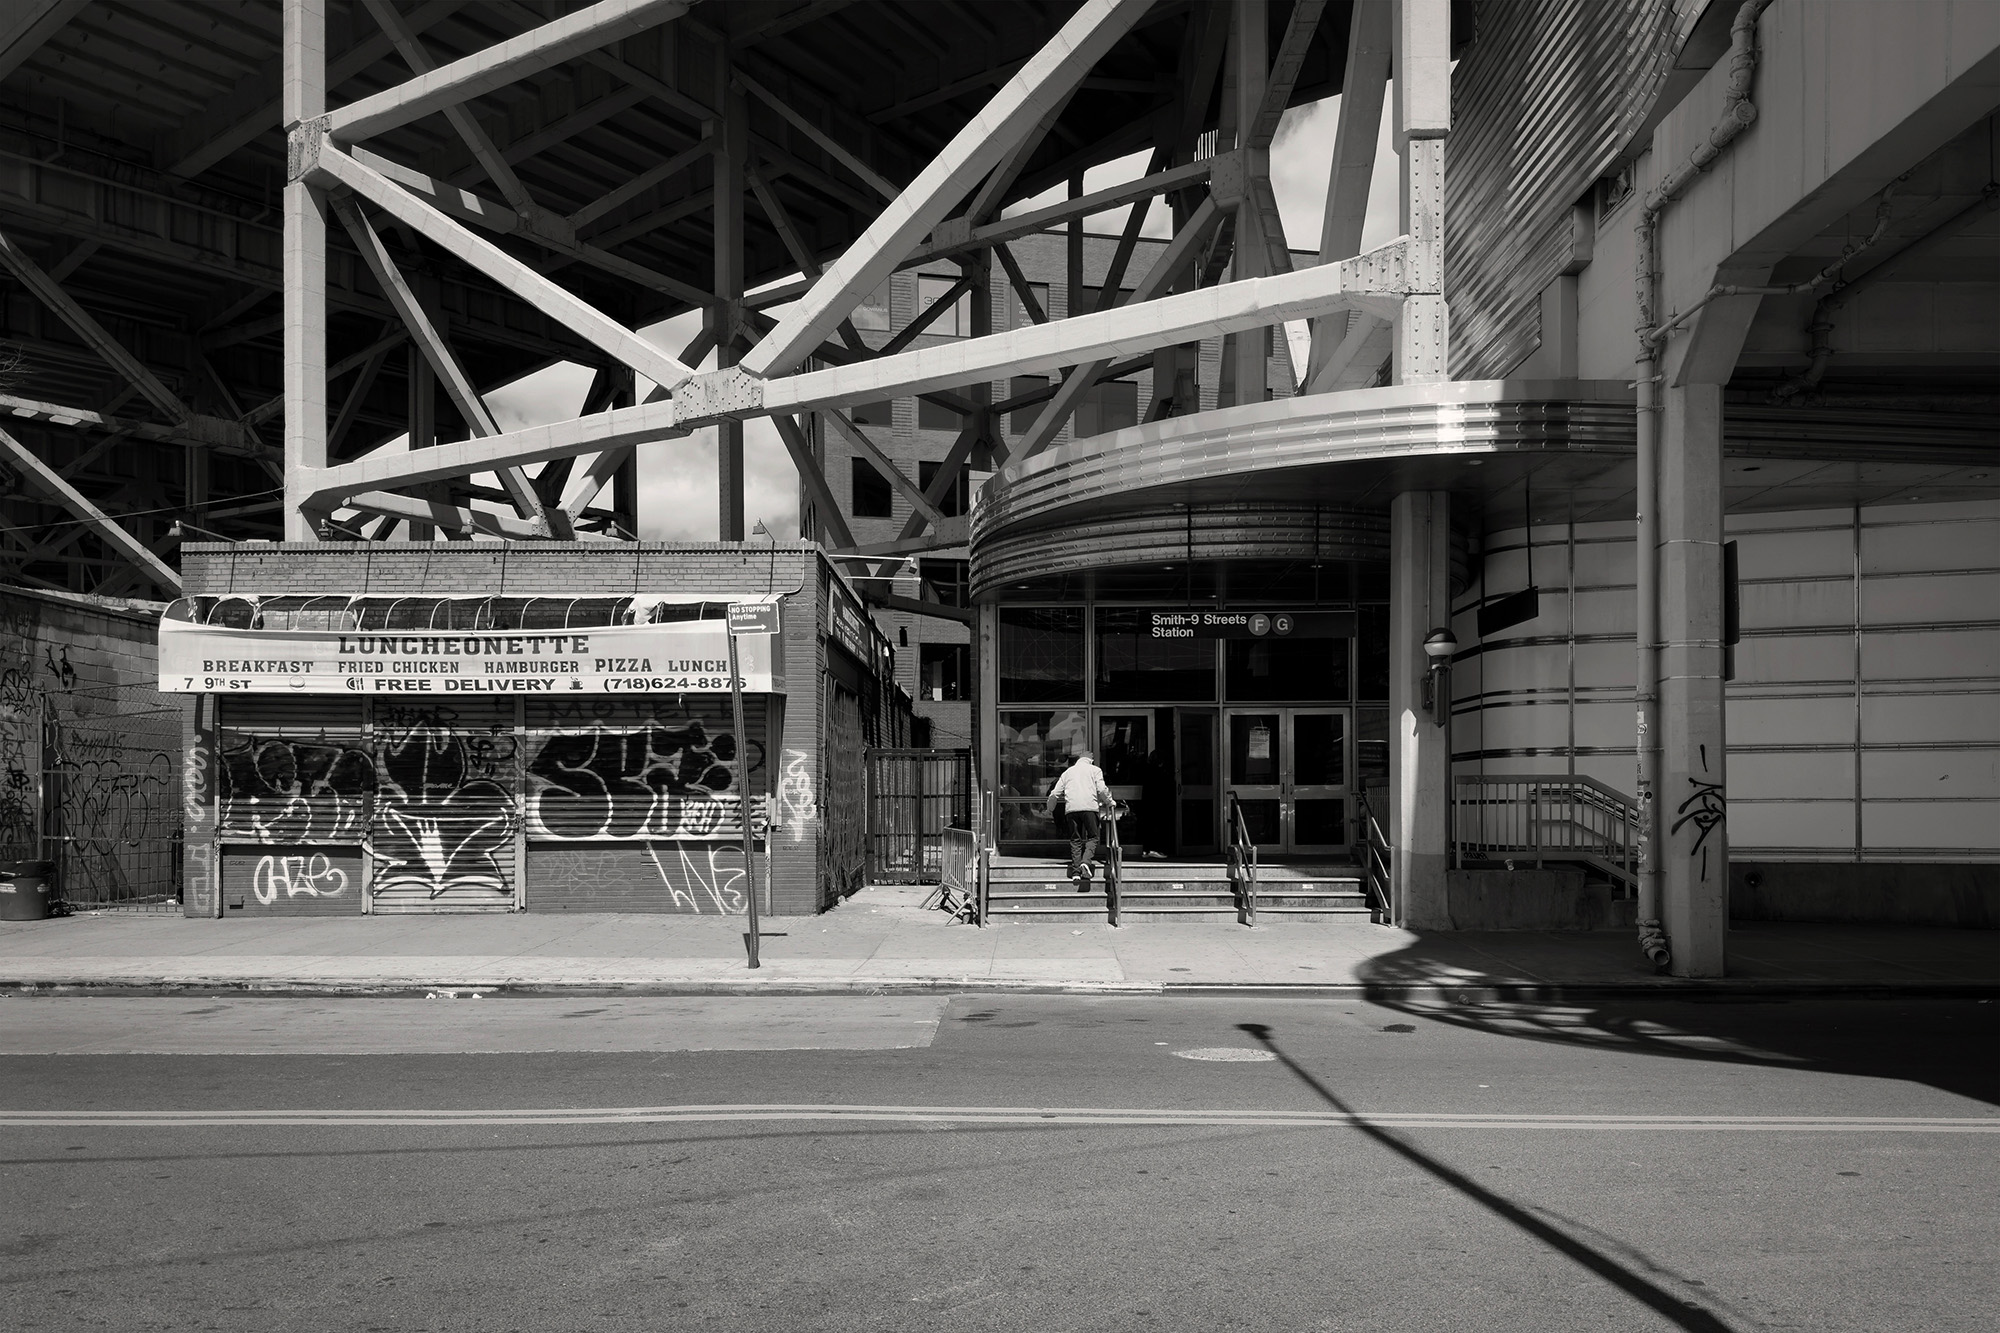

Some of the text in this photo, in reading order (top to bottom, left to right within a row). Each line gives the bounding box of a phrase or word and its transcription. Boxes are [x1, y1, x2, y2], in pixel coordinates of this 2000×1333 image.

[741, 605, 771, 613] STOPPING
[732, 613, 757, 621] Anytime
[1151, 614, 1200, 626] Smith-9
[1203, 614, 1247, 625] Streets
[1151, 627, 1194, 638] Station
[337, 635, 590, 656] LUNCHEONETTE
[202, 657, 728, 674] BREAKFAST FRIED CHICKEN HAMBURGER PIZZA LUNCH
[183, 677, 252, 690] 7 9TH ST
[374, 678, 557, 691] FREE DELIVERY
